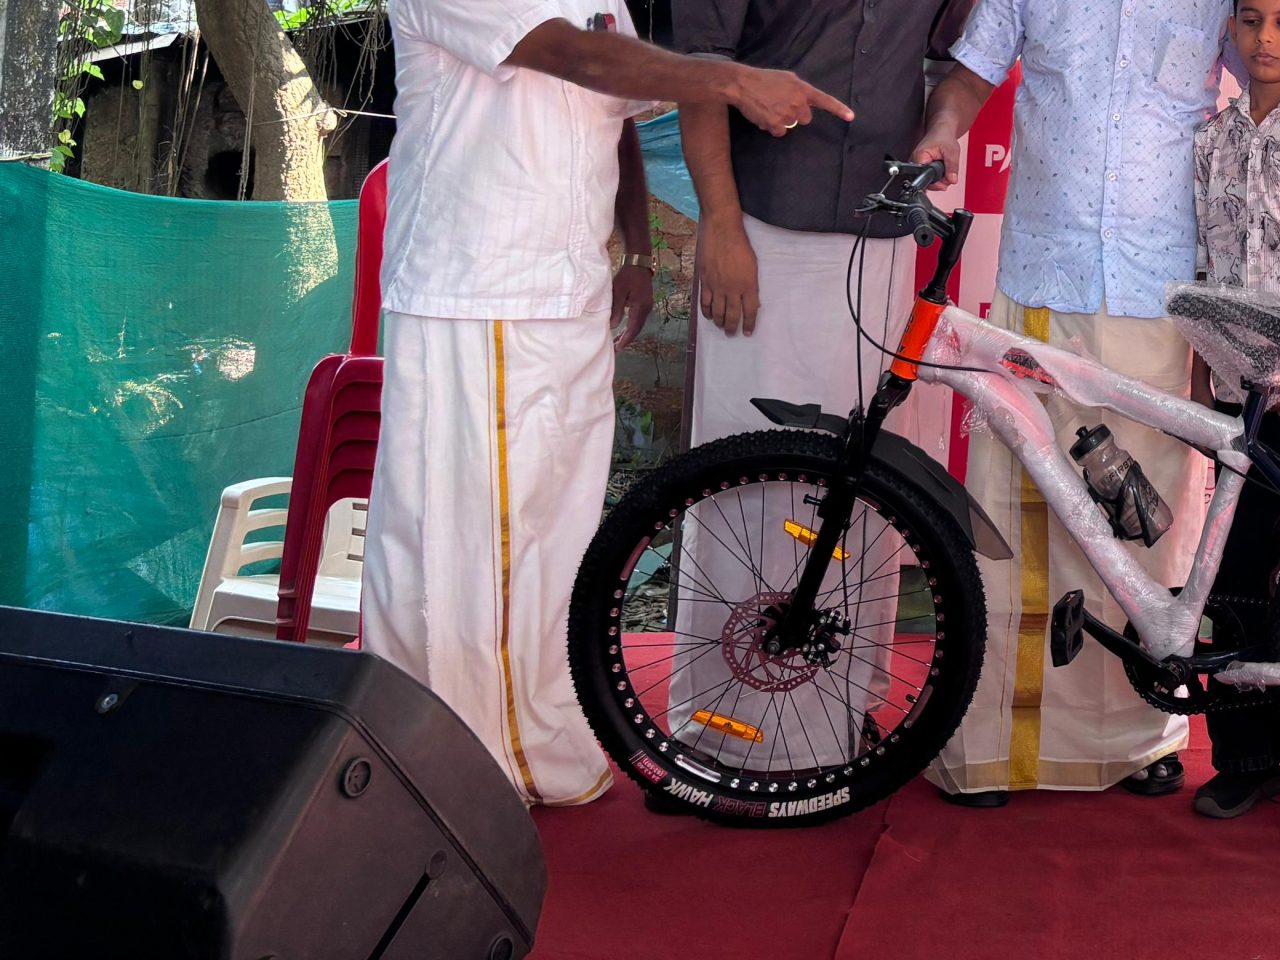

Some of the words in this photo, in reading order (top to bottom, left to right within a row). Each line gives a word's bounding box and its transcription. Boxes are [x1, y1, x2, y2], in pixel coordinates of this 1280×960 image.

[664, 777, 714, 808] HAWK
[715, 796, 767, 818] BLACK
[768, 786, 850, 817] SPEEDWAYS
